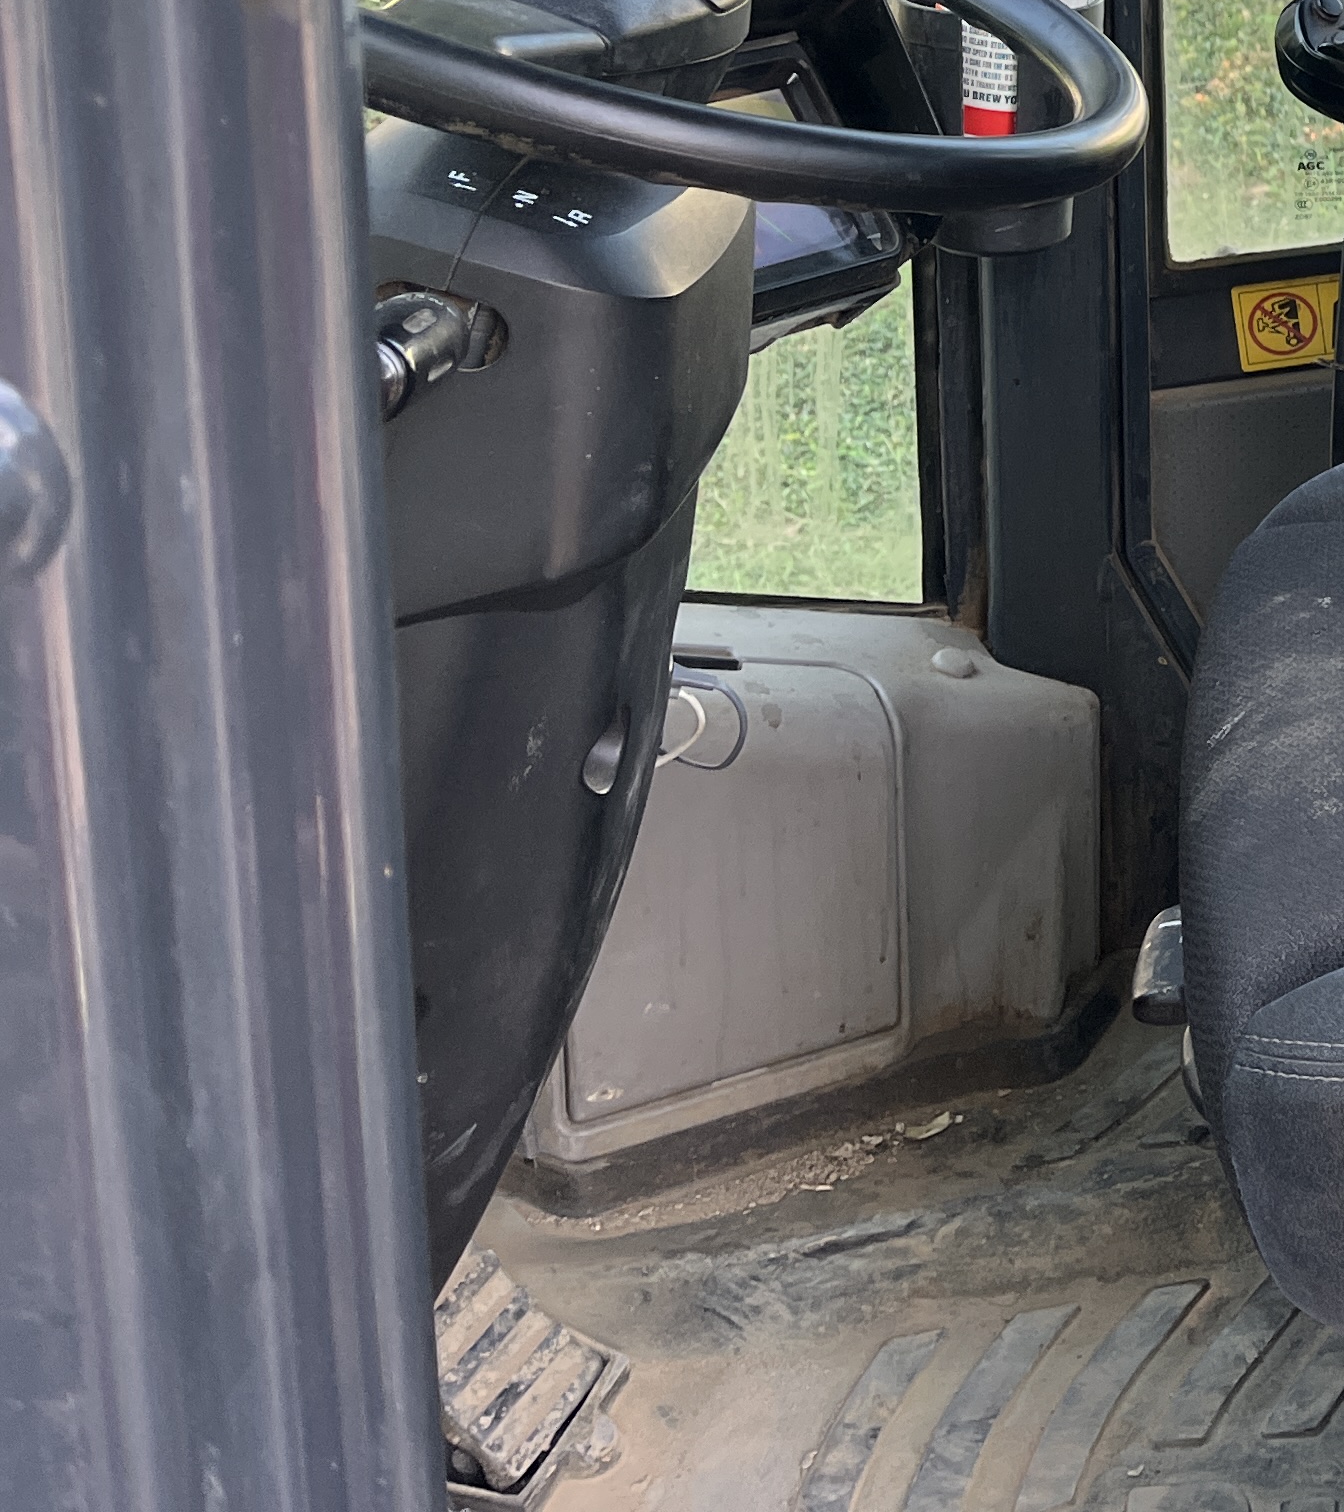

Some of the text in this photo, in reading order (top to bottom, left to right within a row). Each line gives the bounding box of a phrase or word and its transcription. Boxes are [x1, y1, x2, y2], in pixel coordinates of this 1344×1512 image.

[972, 91, 1001, 103] BREW
[1297, 161, 1325, 171] AGC
[448, 170, 470, 183] F
[512, 189, 539, 205] N
[567, 209, 593, 225] R
